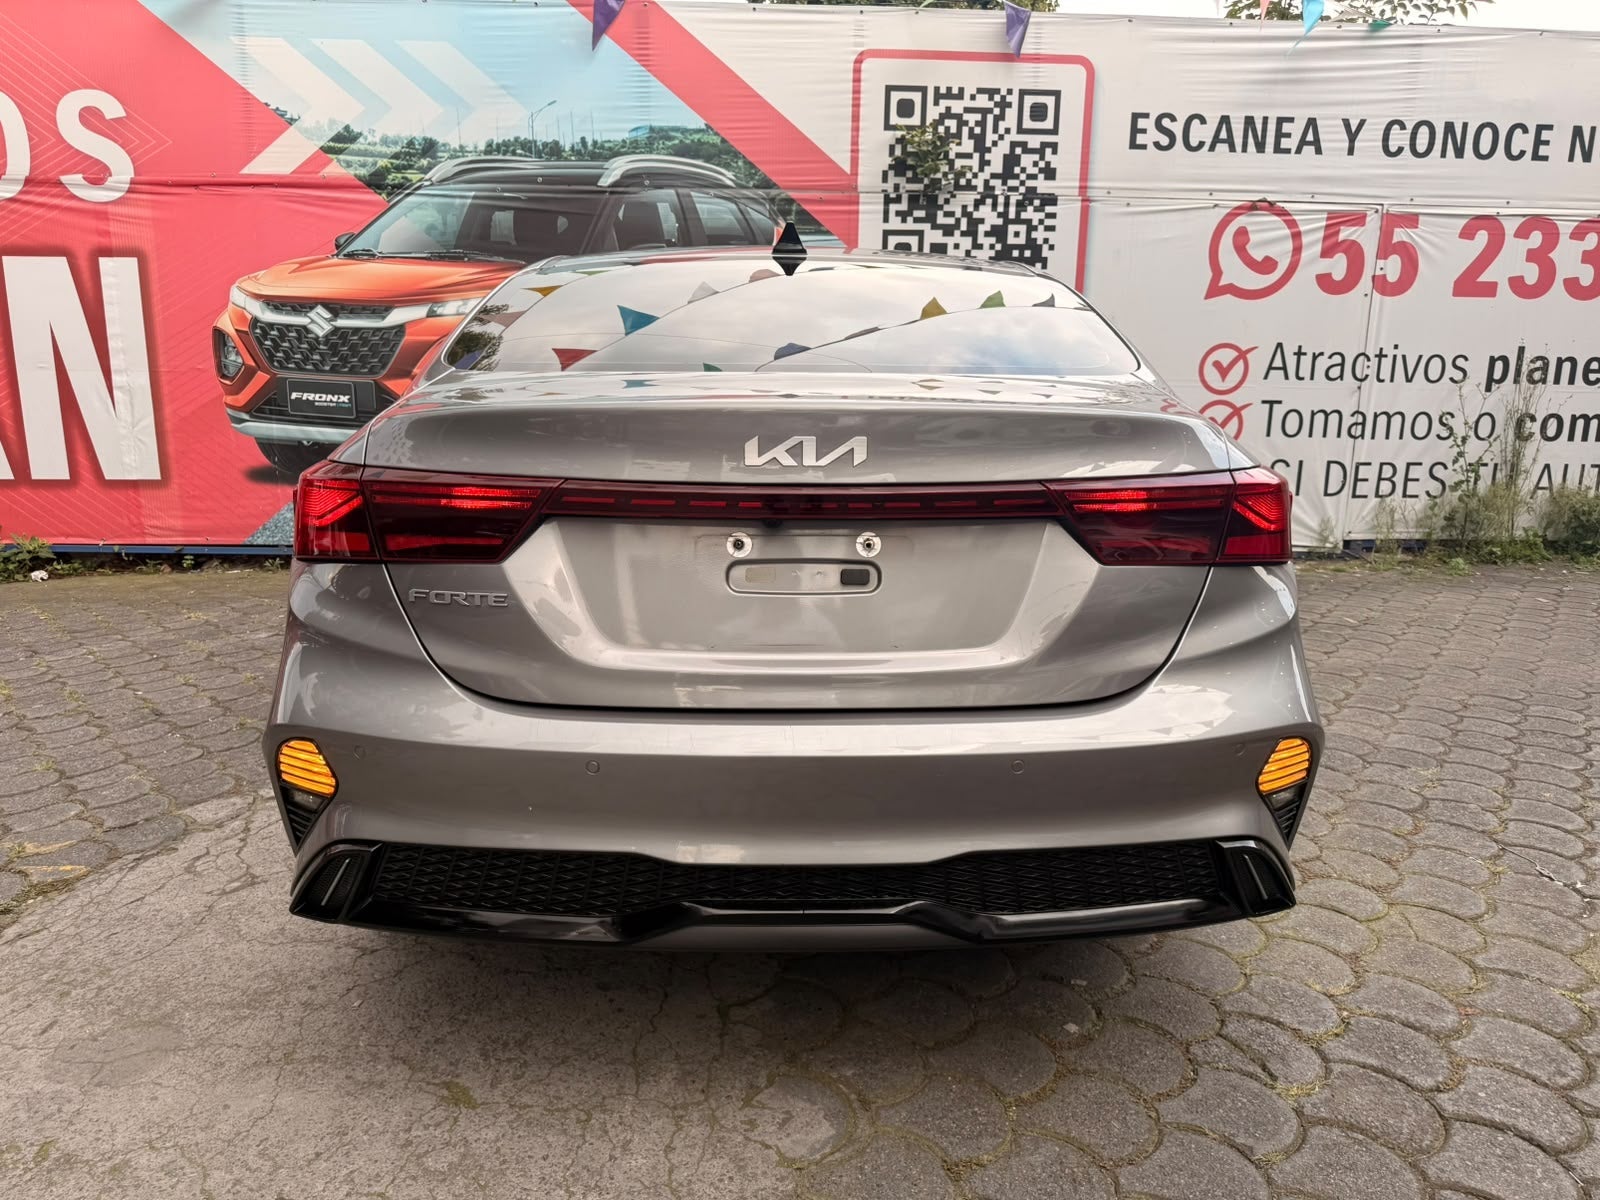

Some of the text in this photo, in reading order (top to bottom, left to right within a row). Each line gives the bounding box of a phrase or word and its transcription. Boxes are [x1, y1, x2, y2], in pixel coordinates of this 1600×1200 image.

[1128, 112, 1322, 156] ESCANEA
[1341, 118, 1367, 156] Y
[1381, 119, 1554, 162] CONOCE
[1314, 212, 1600, 301] 55 233
[0, 256, 162, 481] N
[1263, 342, 1600, 393] Atractivos plane
[290, 391, 351, 403] FRONX
[1261, 399, 1600, 442] Tomamos o com
[744, 435, 868, 467] KIA
[1323, 460, 1450, 499] DEBES
[408, 588, 508, 606] FORTE
